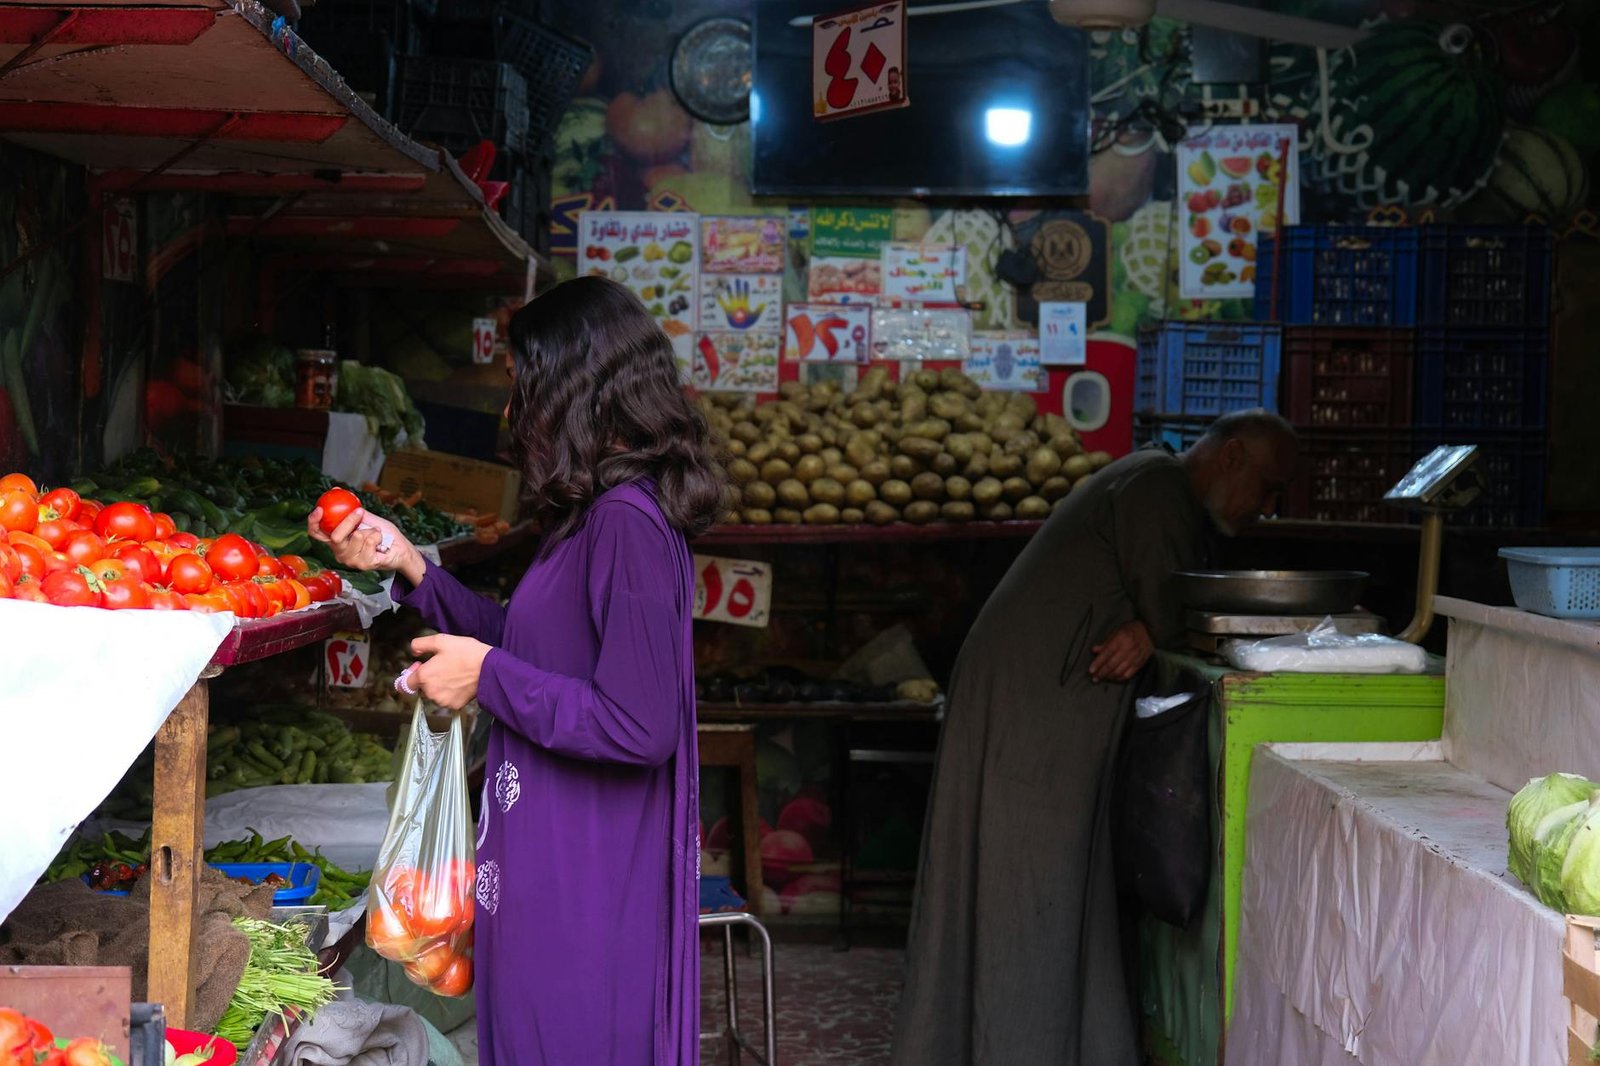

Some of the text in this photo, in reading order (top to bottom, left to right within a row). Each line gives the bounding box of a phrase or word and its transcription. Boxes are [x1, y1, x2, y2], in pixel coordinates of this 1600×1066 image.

[824, 26, 887, 109] ٤٠
[631, 223, 658, 244] بلدي
[660, 221, 691, 241] خضار
[702, 559, 755, 619] ١٥
[327, 640, 364, 688] ٢٠
